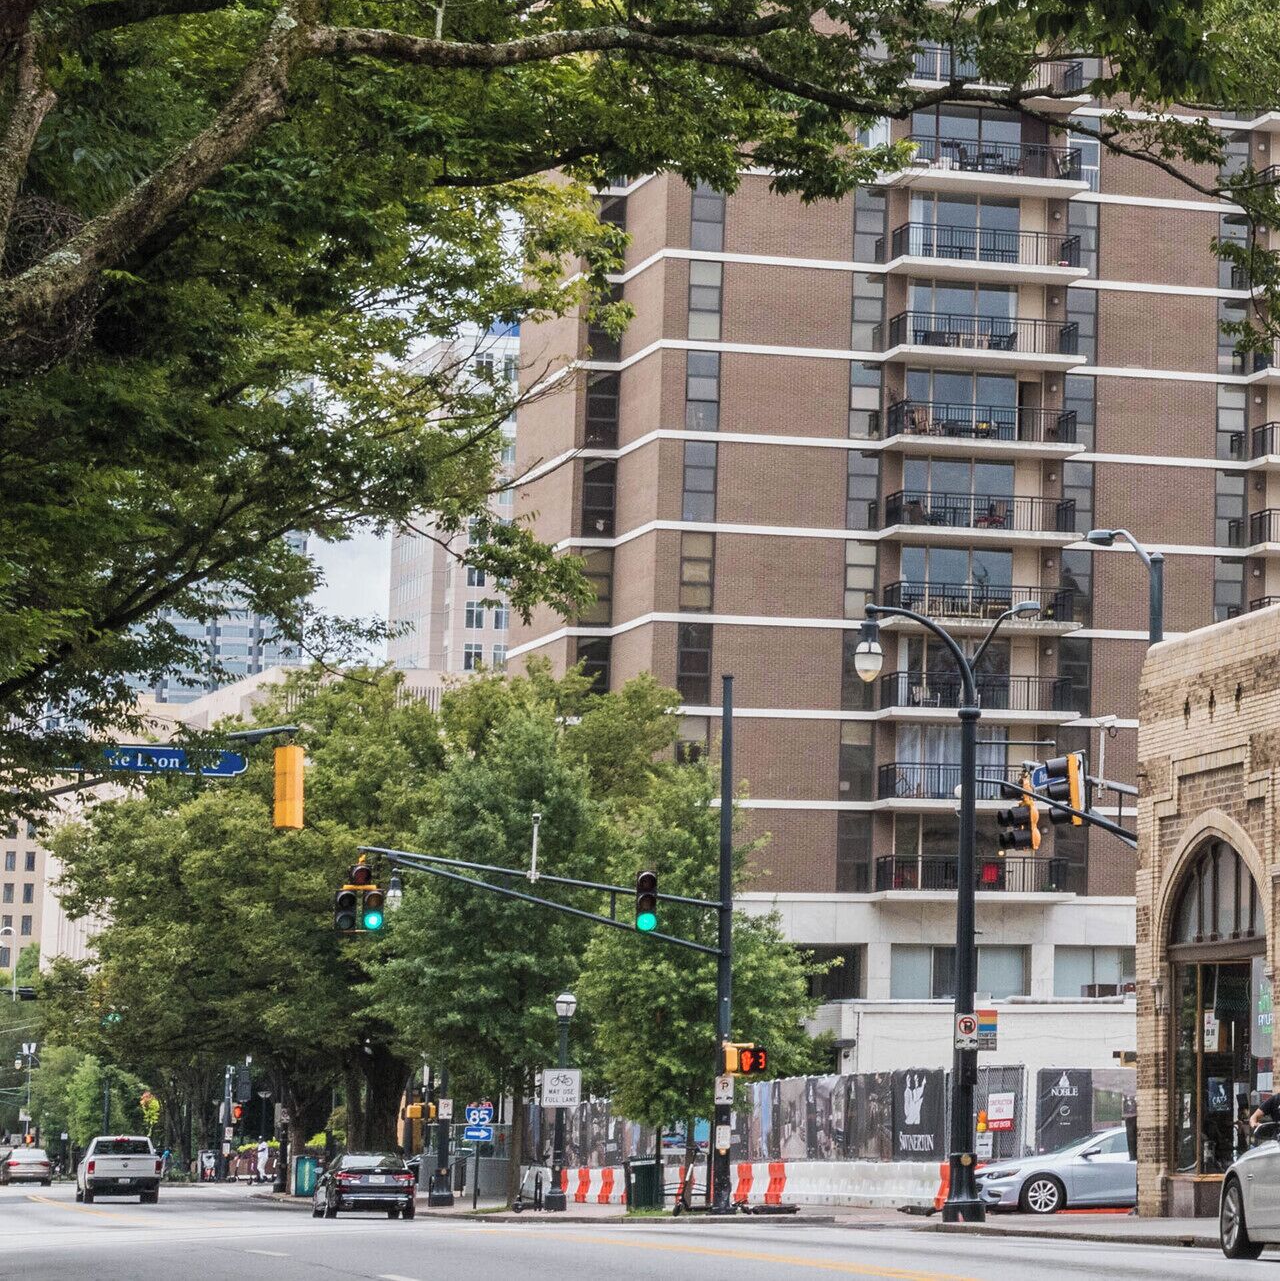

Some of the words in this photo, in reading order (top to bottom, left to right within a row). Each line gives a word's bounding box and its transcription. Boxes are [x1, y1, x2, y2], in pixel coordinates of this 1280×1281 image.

[759, 1052, 766, 1069] 3
[1051, 1086, 1078, 1097] NOBLE
[470, 1110, 489, 1125] 85
